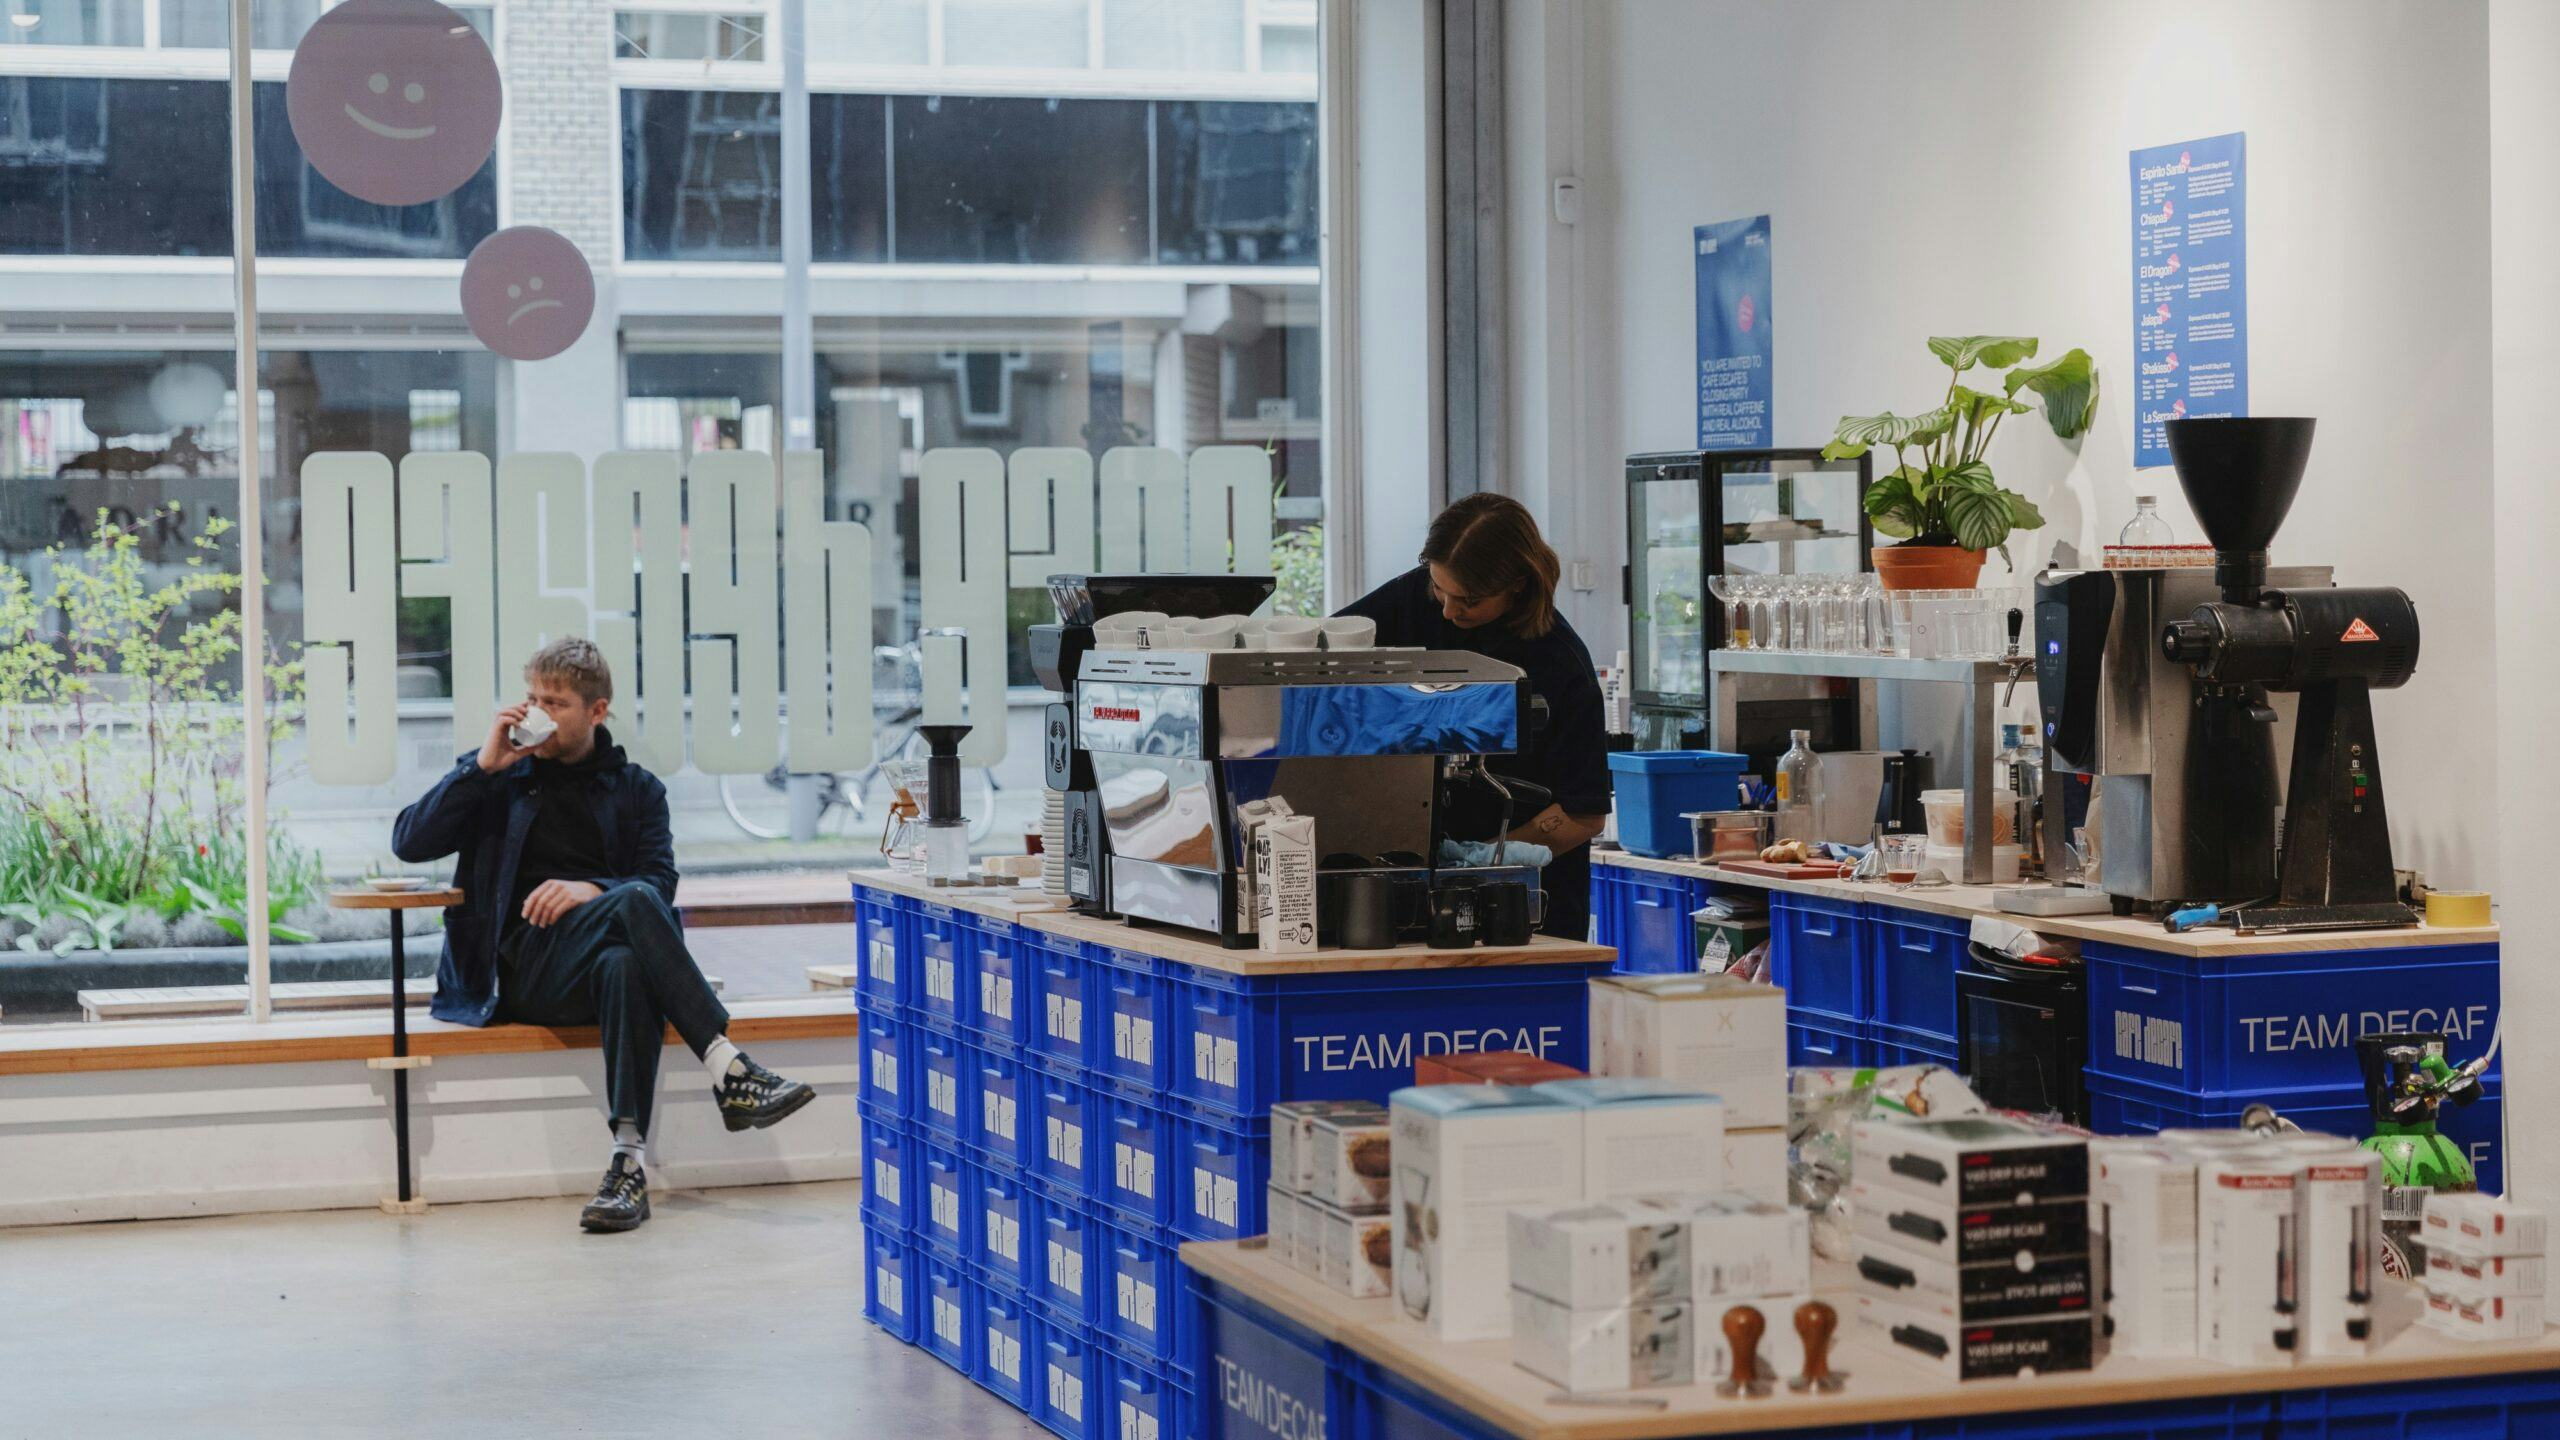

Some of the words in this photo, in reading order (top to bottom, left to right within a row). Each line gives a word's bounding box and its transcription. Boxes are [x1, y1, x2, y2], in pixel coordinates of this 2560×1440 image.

[1752, 355, 1762, 368] TO
[2239, 1013, 2348, 1052] TEAM
[2360, 1005, 2488, 1041] DECAF
[1294, 1032, 1411, 1072] TEAM
[1424, 1026, 1562, 1060] DECAF
[2014, 1165, 2047, 1179] SCALE
[2014, 1223, 2045, 1237] SCALE
[2006, 1285, 2038, 1298] SCALE
[2016, 1340, 2048, 1353] SCALE
[1215, 1353, 1264, 1426] TEAM
